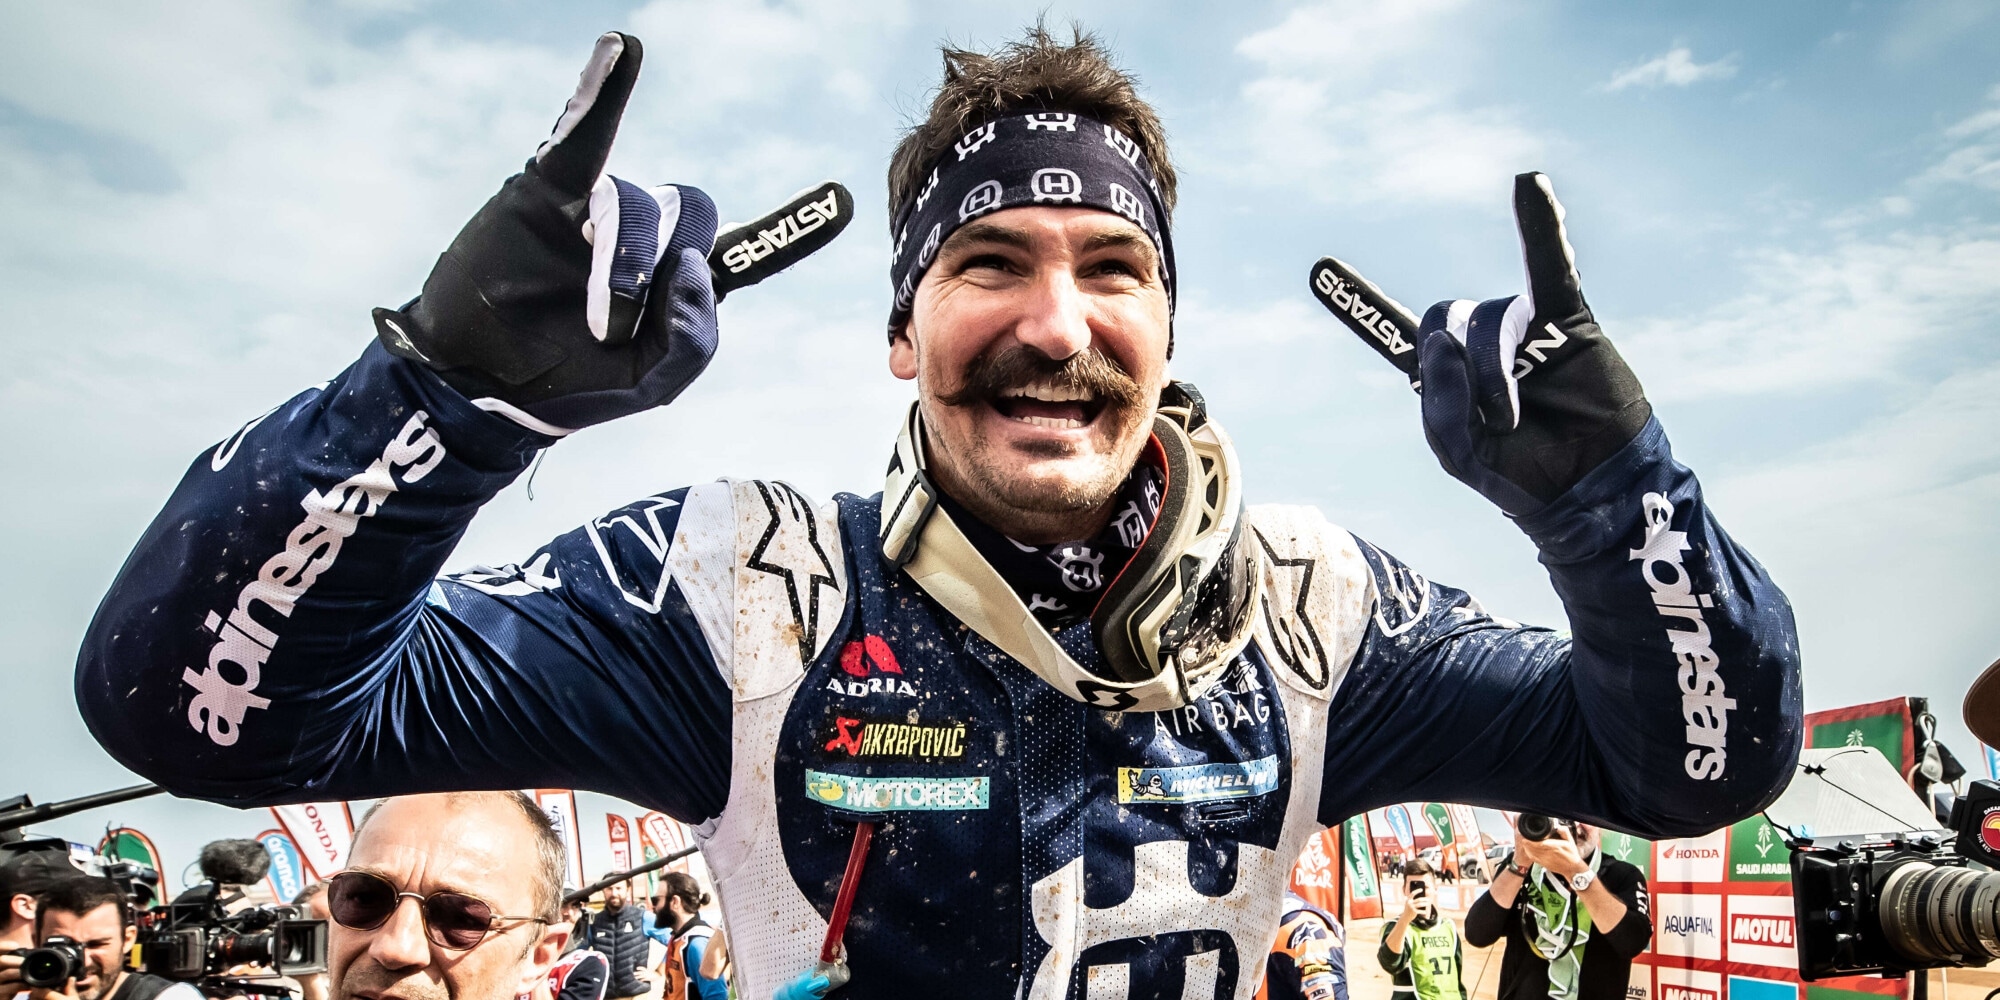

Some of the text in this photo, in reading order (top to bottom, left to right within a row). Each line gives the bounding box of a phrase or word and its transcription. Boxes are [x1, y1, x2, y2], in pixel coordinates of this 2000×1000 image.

[722, 189, 838, 274] ASTARS
[1315, 267, 1415, 356] ASTARS
[181, 409, 447, 747] alpinestars
[1628, 490, 1738, 781] alpinestars
[826, 678, 917, 697] ADRIA
[860, 723, 966, 758] AKRAPOVIČ
[846, 781, 983, 808] MOTOREX
[1169, 772, 1268, 793] MICHELIN
[304, 804, 339, 863] ONDA
[267, 836, 299, 899] aramco
[1676, 849, 1720, 859] HONDA
[1736, 863, 1791, 875] SAUDI ARABIA
[1664, 915, 1714, 937] AQUAFINA
[1733, 917, 1793, 944] MOTUL
[1421, 936, 1450, 949] PRESS
[1428, 956, 1452, 976] 17
[1626, 985, 1647, 998] drich
